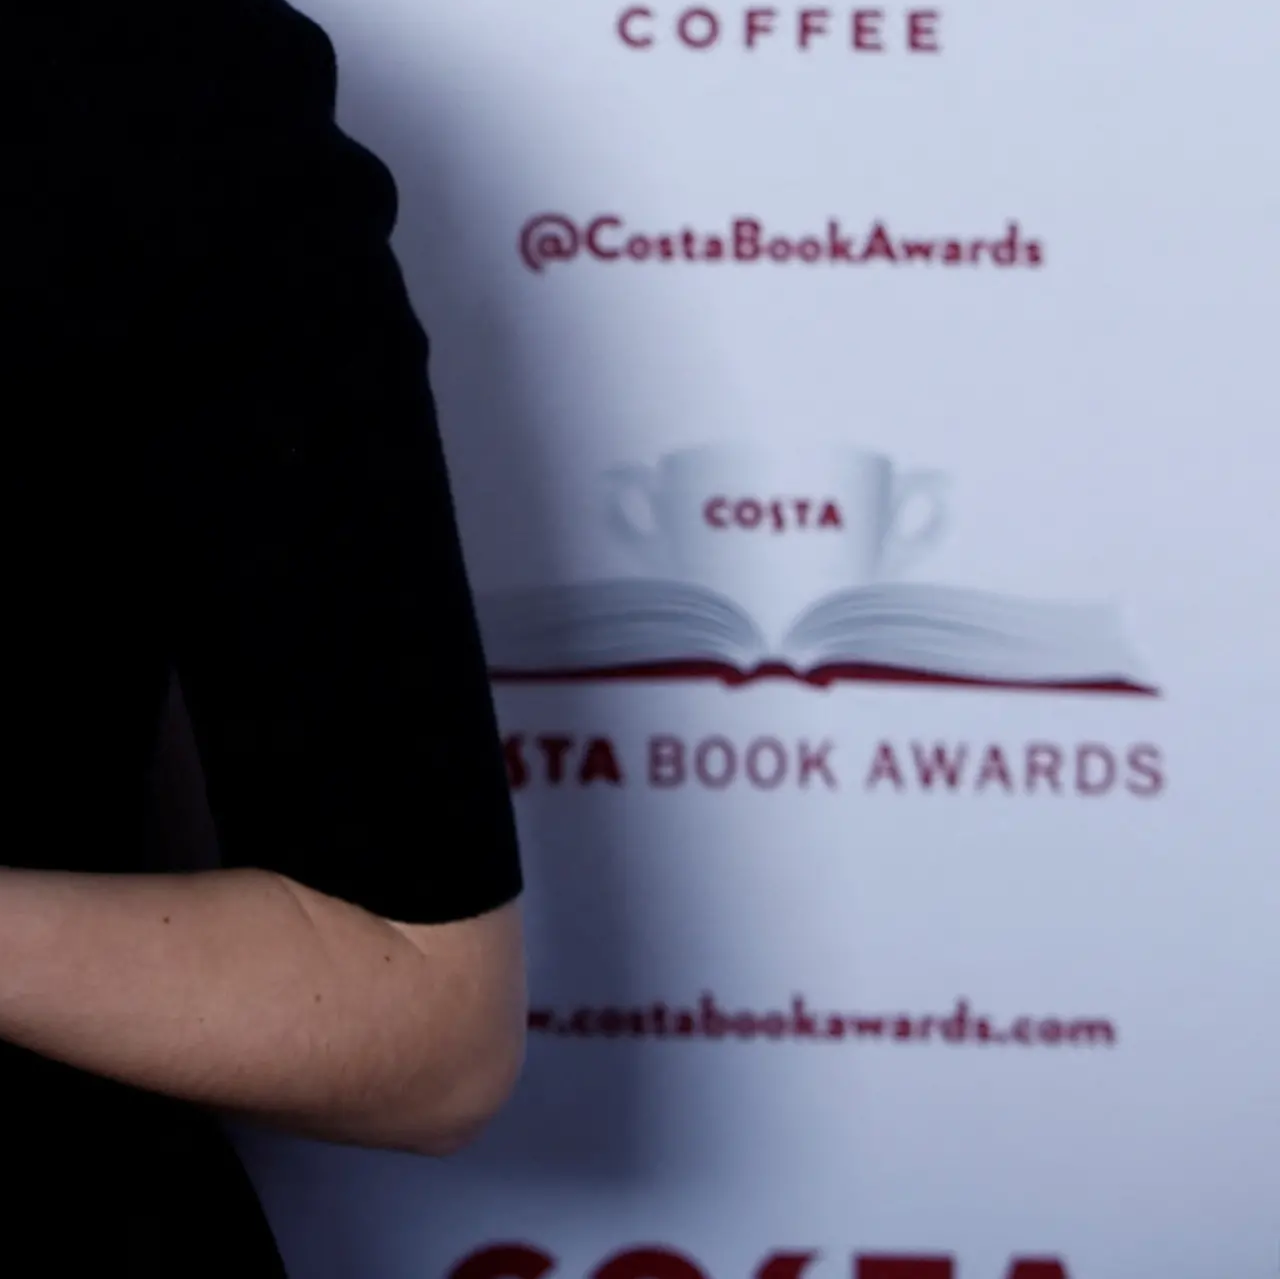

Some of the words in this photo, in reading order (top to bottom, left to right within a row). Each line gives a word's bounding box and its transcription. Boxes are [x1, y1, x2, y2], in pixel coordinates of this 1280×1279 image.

[617, 6, 938, 52] COFFEE
[520, 216, 1043, 270] @CostaBookAwards
[704, 498, 843, 532] COSTA
[648, 736, 837, 791] BOOK
[867, 741, 1164, 796] AWARDS
